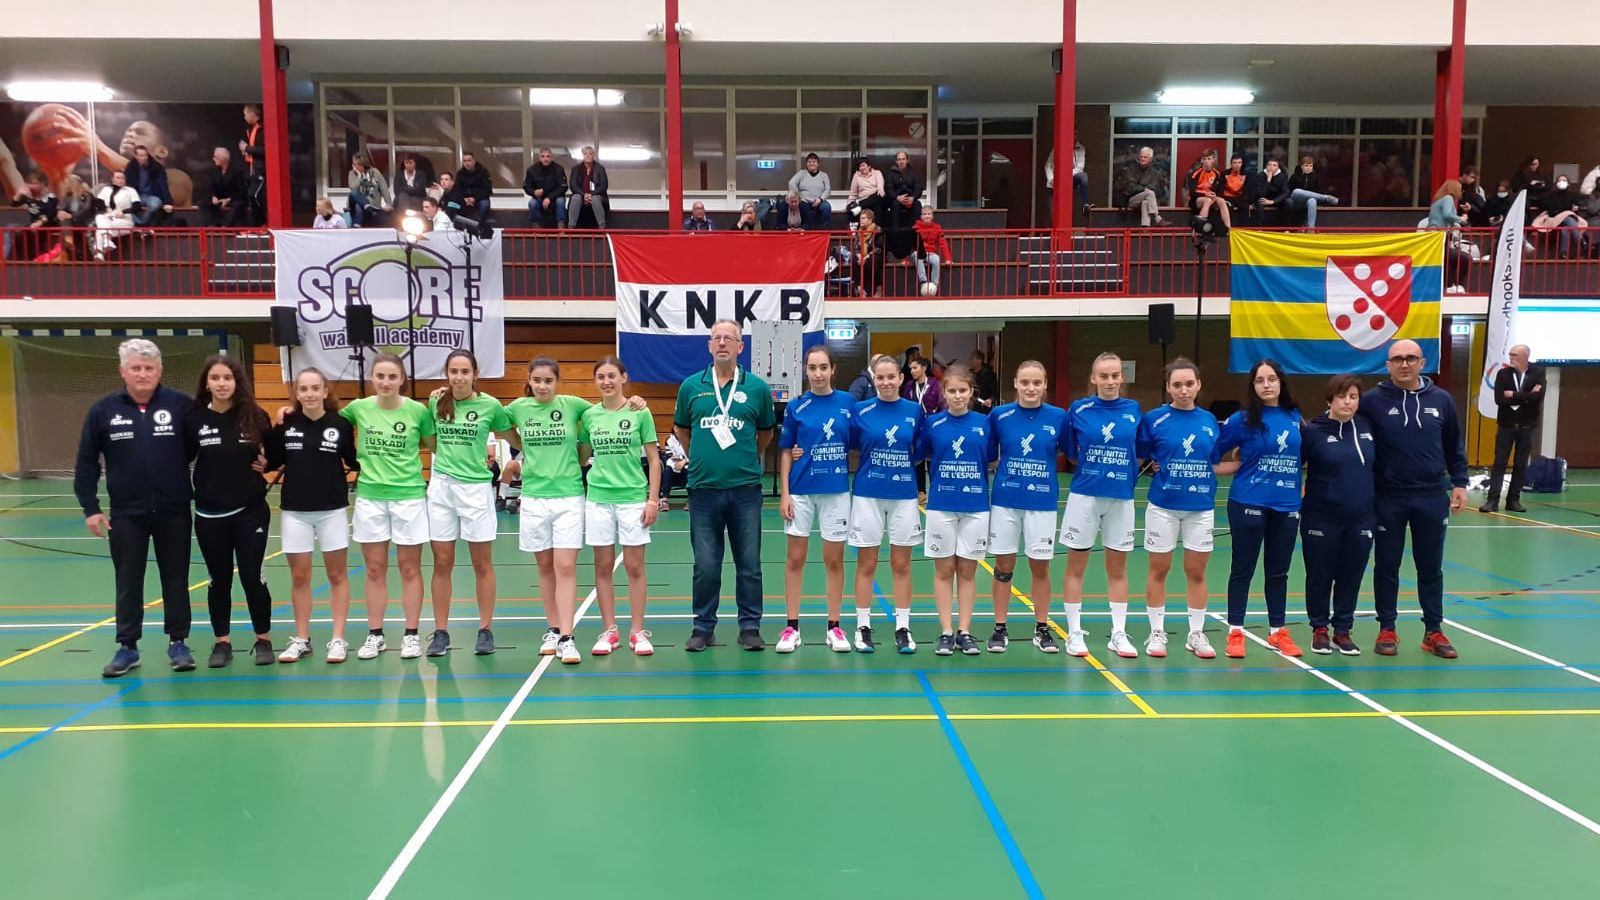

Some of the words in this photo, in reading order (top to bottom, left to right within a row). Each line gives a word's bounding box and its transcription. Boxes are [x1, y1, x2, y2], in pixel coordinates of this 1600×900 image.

[298, 259, 483, 323] SCORE
[391, 327, 461, 347] academy
[524, 429, 566, 437] EUSKADI
[365, 437, 406, 448] EUSKADI
[592, 437, 632, 446] EUSKADI
[1167, 463, 1209, 471] COMUNITAT
[1180, 470, 1212, 478] L'ESPORT
